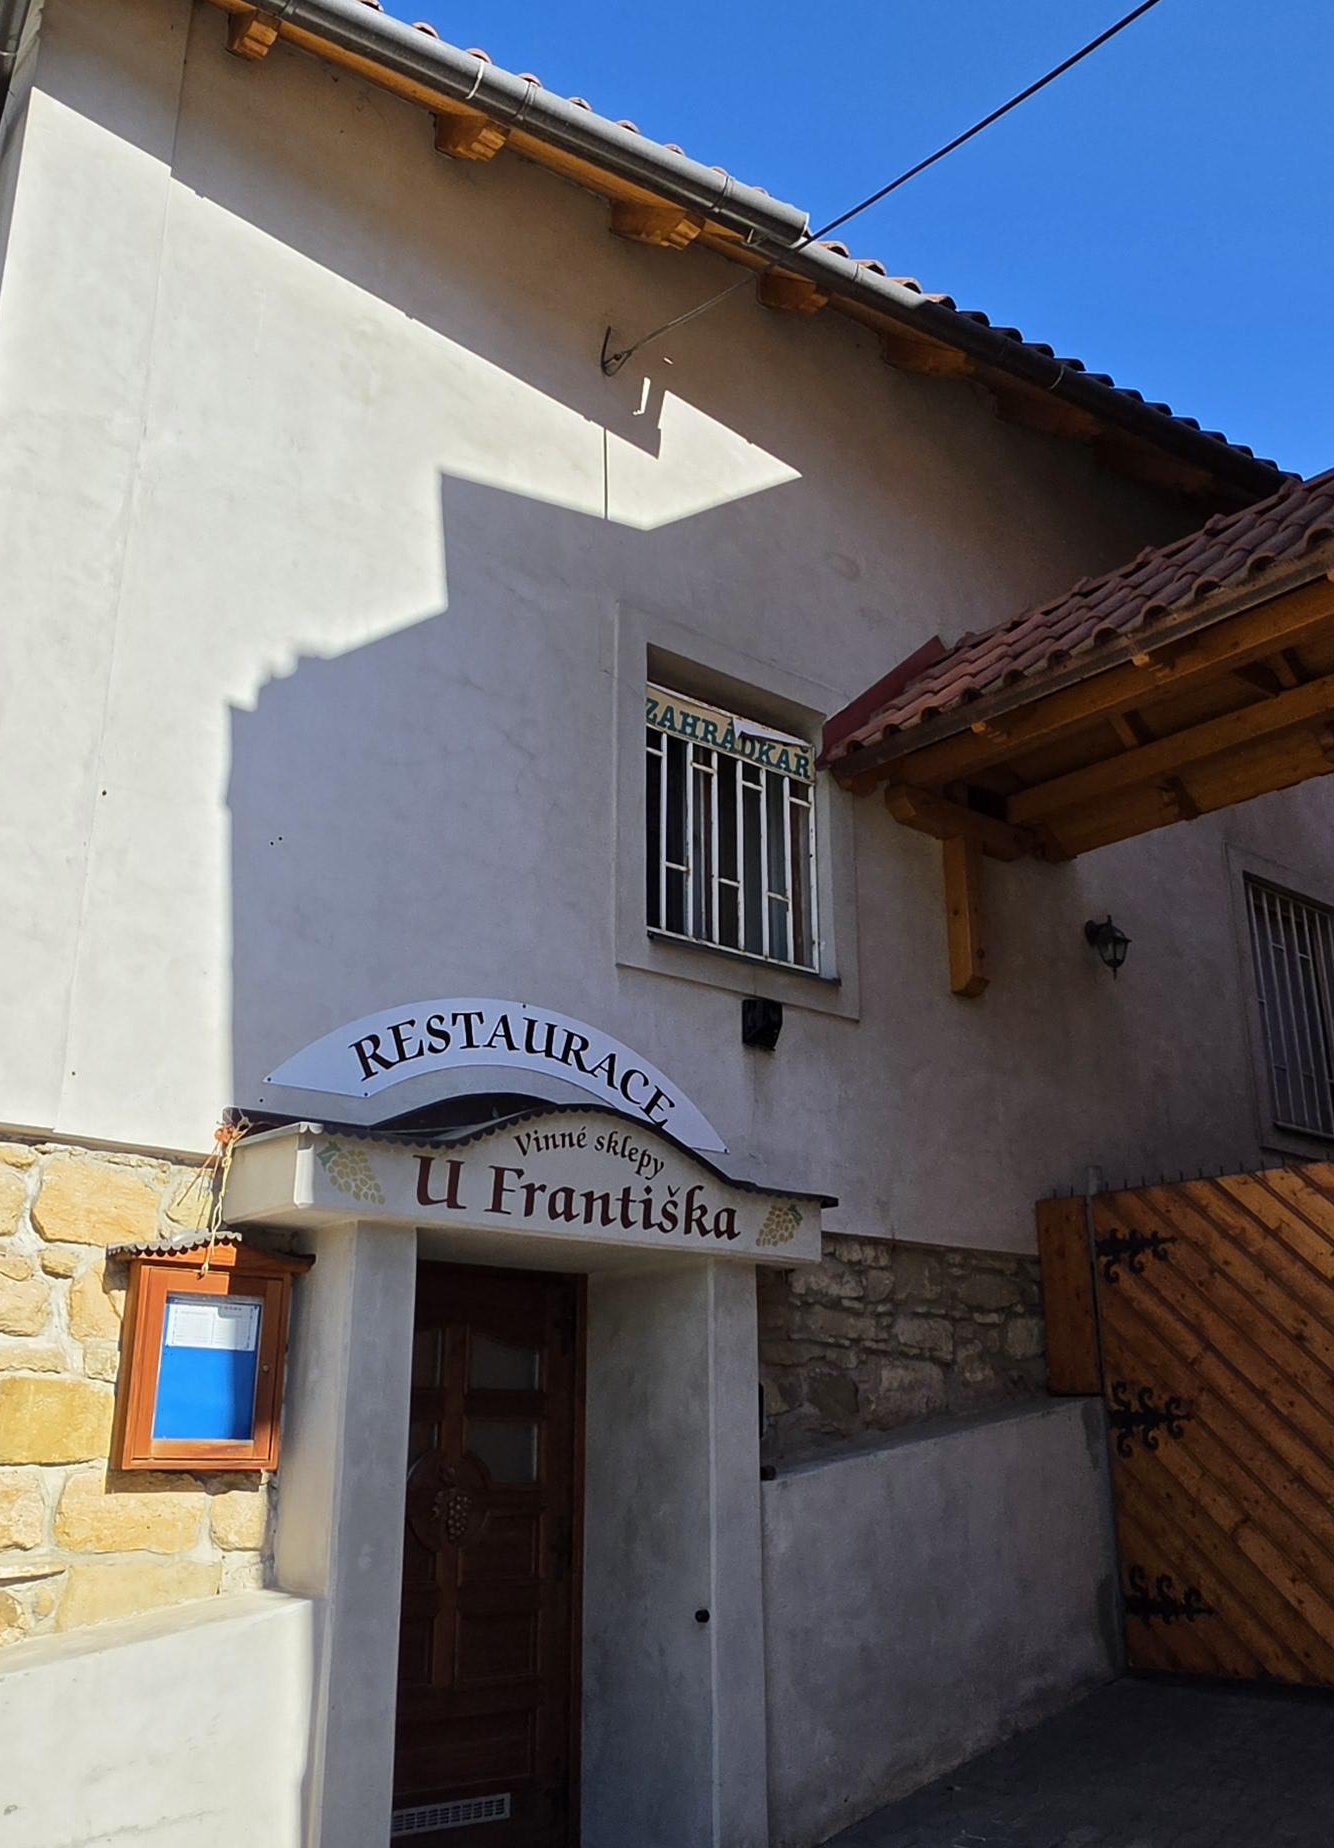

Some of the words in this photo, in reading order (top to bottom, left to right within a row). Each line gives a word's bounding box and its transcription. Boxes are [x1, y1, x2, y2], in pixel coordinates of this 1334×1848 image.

[348, 1011, 676, 1130] RESTAURACE
[513, 1125, 588, 1157] Vinné
[594, 1130, 665, 1181] sklepy
[413, 1155, 468, 1210] U
[484, 1165, 741, 1243] Františka
